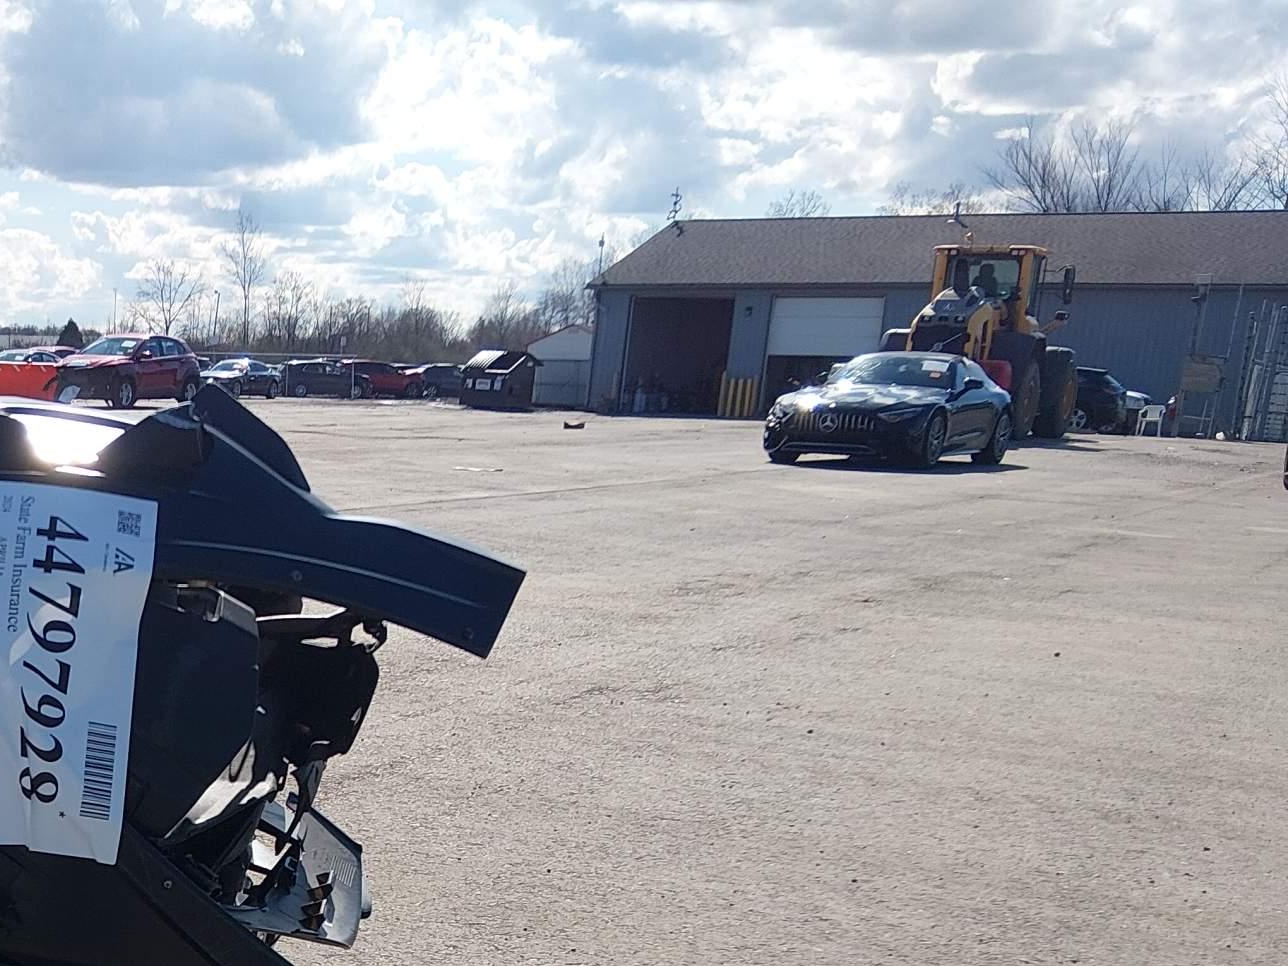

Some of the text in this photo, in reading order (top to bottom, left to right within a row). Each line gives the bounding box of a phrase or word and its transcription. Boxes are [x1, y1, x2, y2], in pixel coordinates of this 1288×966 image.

[7, 495, 35, 633] State Farm Insurance
[18, 515, 89, 804] 44797928
